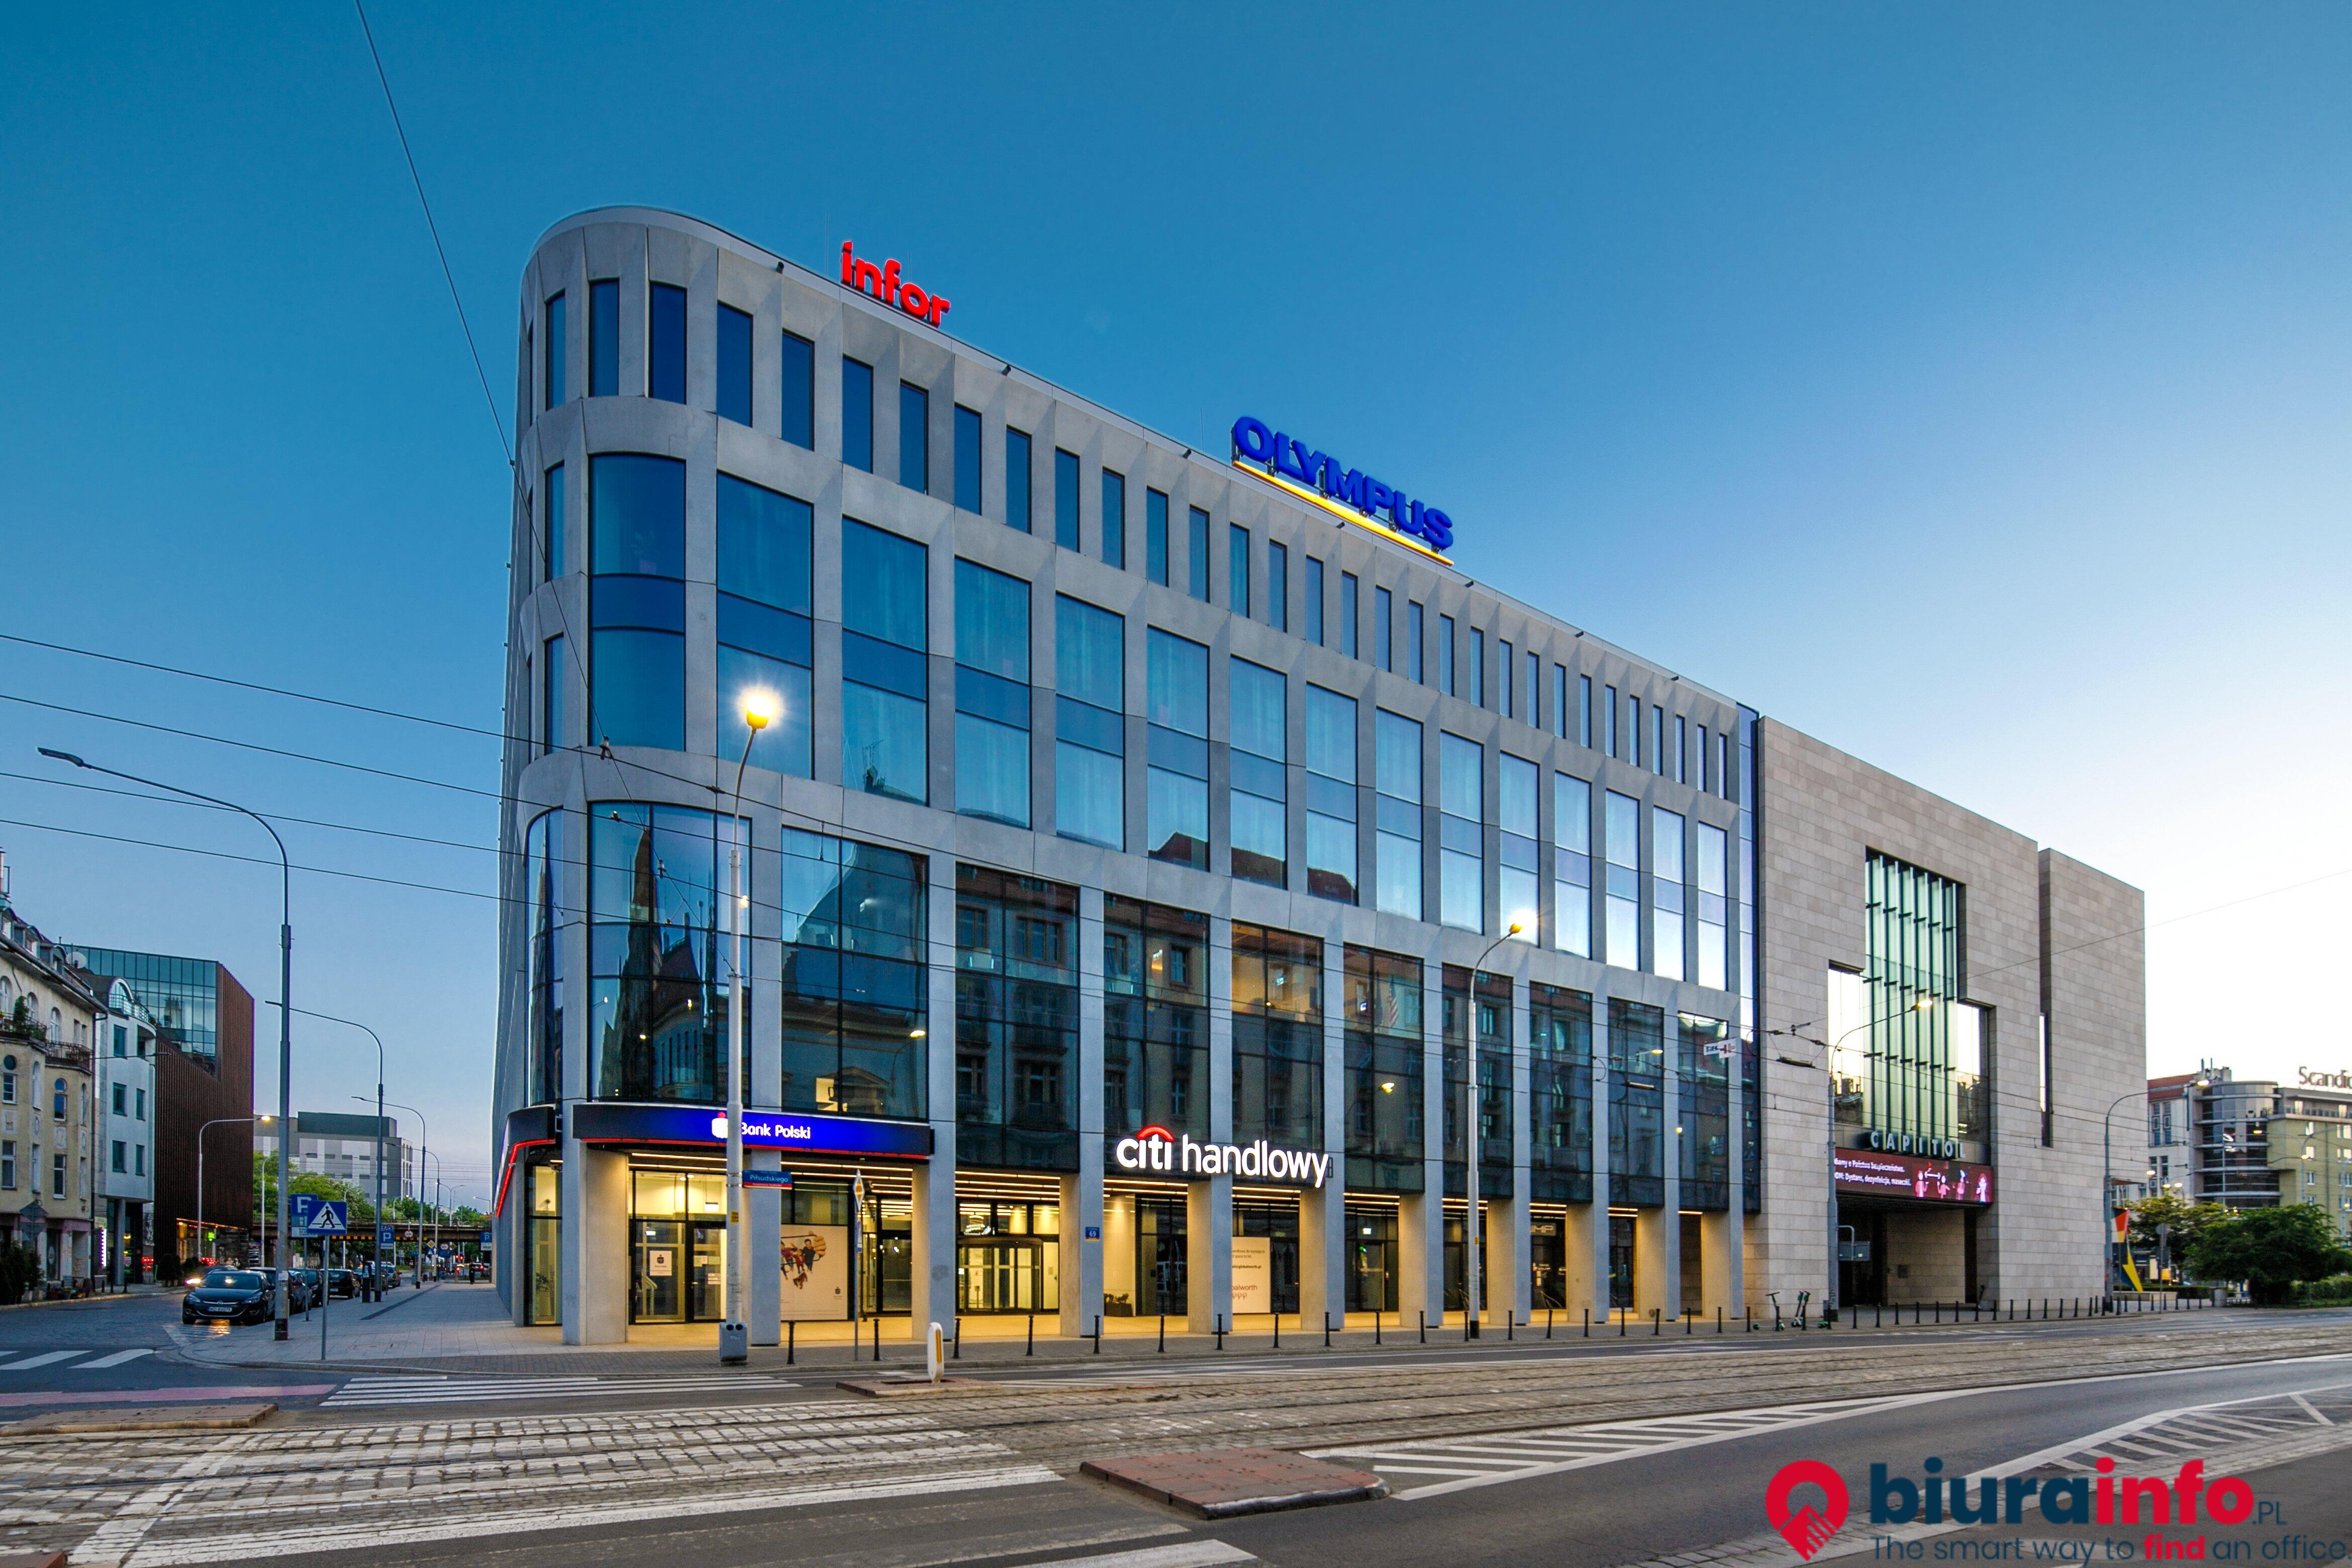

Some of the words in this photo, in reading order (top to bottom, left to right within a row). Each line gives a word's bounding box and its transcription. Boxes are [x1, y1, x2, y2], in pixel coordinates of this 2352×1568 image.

[840, 240, 951, 328] infor
[1233, 416, 1454, 549] OLYMPUS
[741, 1122, 771, 1136] Bank
[775, 1124, 811, 1139] Polski
[1871, 1131, 1966, 1158] CAPITOL
[1116, 1131, 1172, 1170] citi
[1182, 1133, 1329, 1189] handlowy
